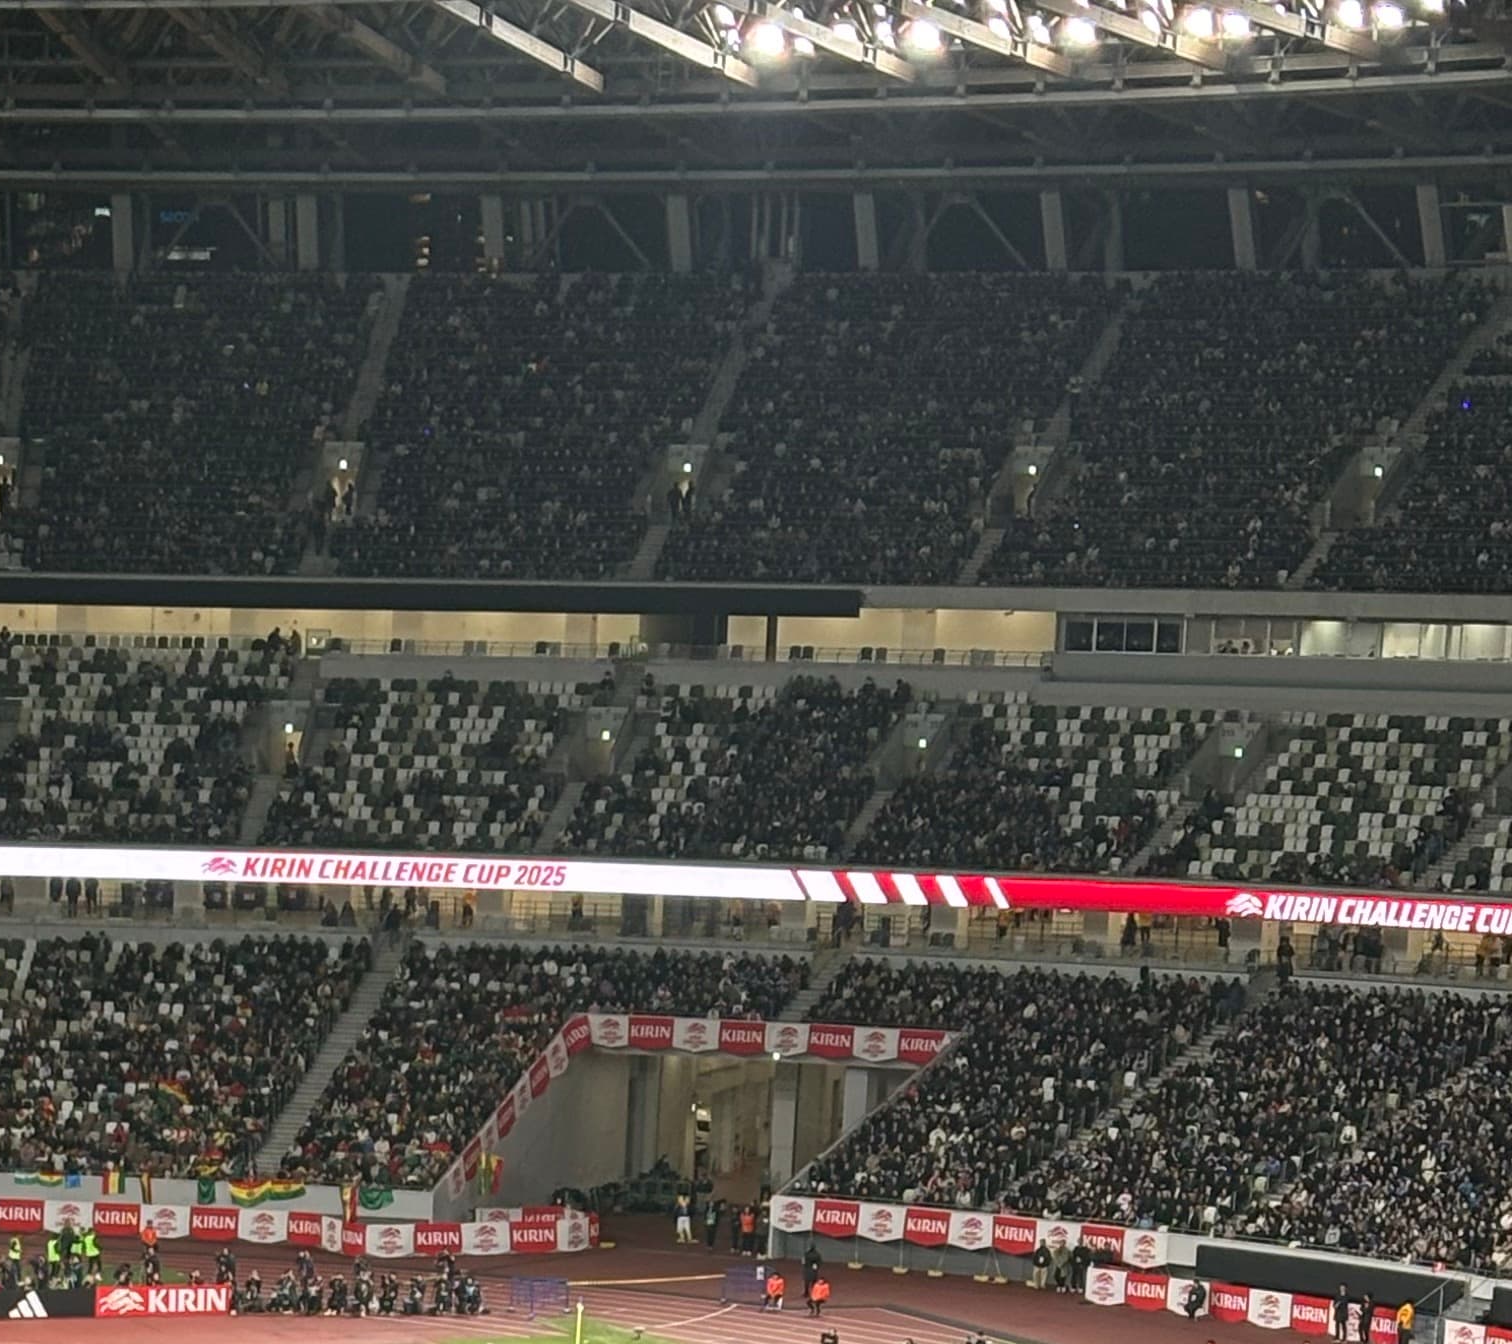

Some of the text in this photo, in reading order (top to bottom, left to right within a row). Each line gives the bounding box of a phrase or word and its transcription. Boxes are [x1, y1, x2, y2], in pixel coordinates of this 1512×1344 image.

[242, 857, 567, 887] KIRIN CHALLENGE CUP 2025
[1263, 894, 1512, 935] KIRIN CHALLENGE CU
[630, 1024, 671, 1039] KIRIN
[721, 1029, 763, 1044] KIRIN
[810, 1032, 851, 1048] KIRIN
[900, 1037, 941, 1053] KIRIN
[94, 1210, 138, 1225] KIRIN
[192, 1214, 236, 1229] KIRIN
[815, 1209, 857, 1226] KIRIN
[906, 1217, 948, 1234] KIRIN
[416, 1231, 460, 1246] KIRIN
[513, 1229, 555, 1243] KIRIN
[994, 1223, 1035, 1243] KIRIN
[1127, 1283, 1166, 1300] KIRIN
[148, 1288, 227, 1313] KIRIN
[1211, 1293, 1247, 1311] KIRIN
[1292, 1305, 1328, 1324] KIRIN
[1371, 1316, 1398, 1334] KIRI
